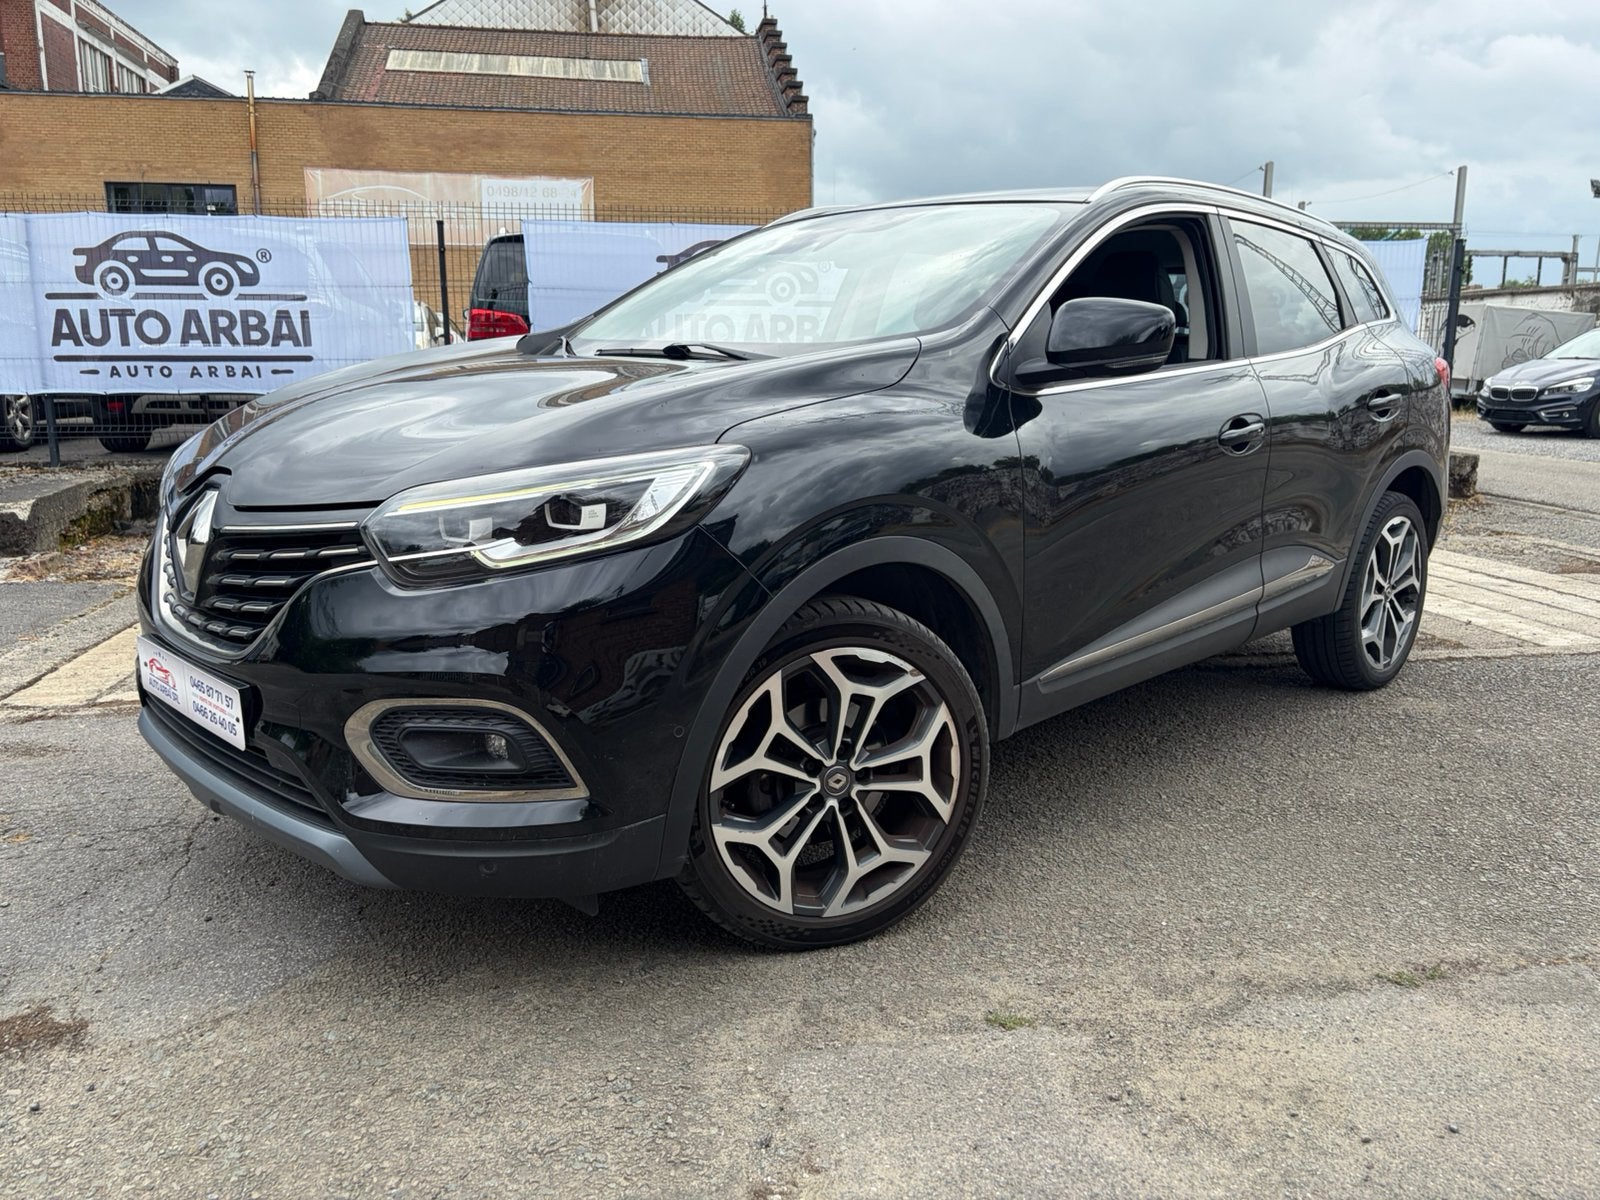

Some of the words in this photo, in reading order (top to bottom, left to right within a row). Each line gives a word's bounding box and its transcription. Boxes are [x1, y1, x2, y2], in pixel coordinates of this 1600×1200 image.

[51, 308, 171, 347] AUTO
[179, 309, 313, 348] ARBAI
[109, 365, 173, 379] AUTO
[190, 365, 262, 379] ARBAI
[956, 745, 981, 838] MICHELIN
